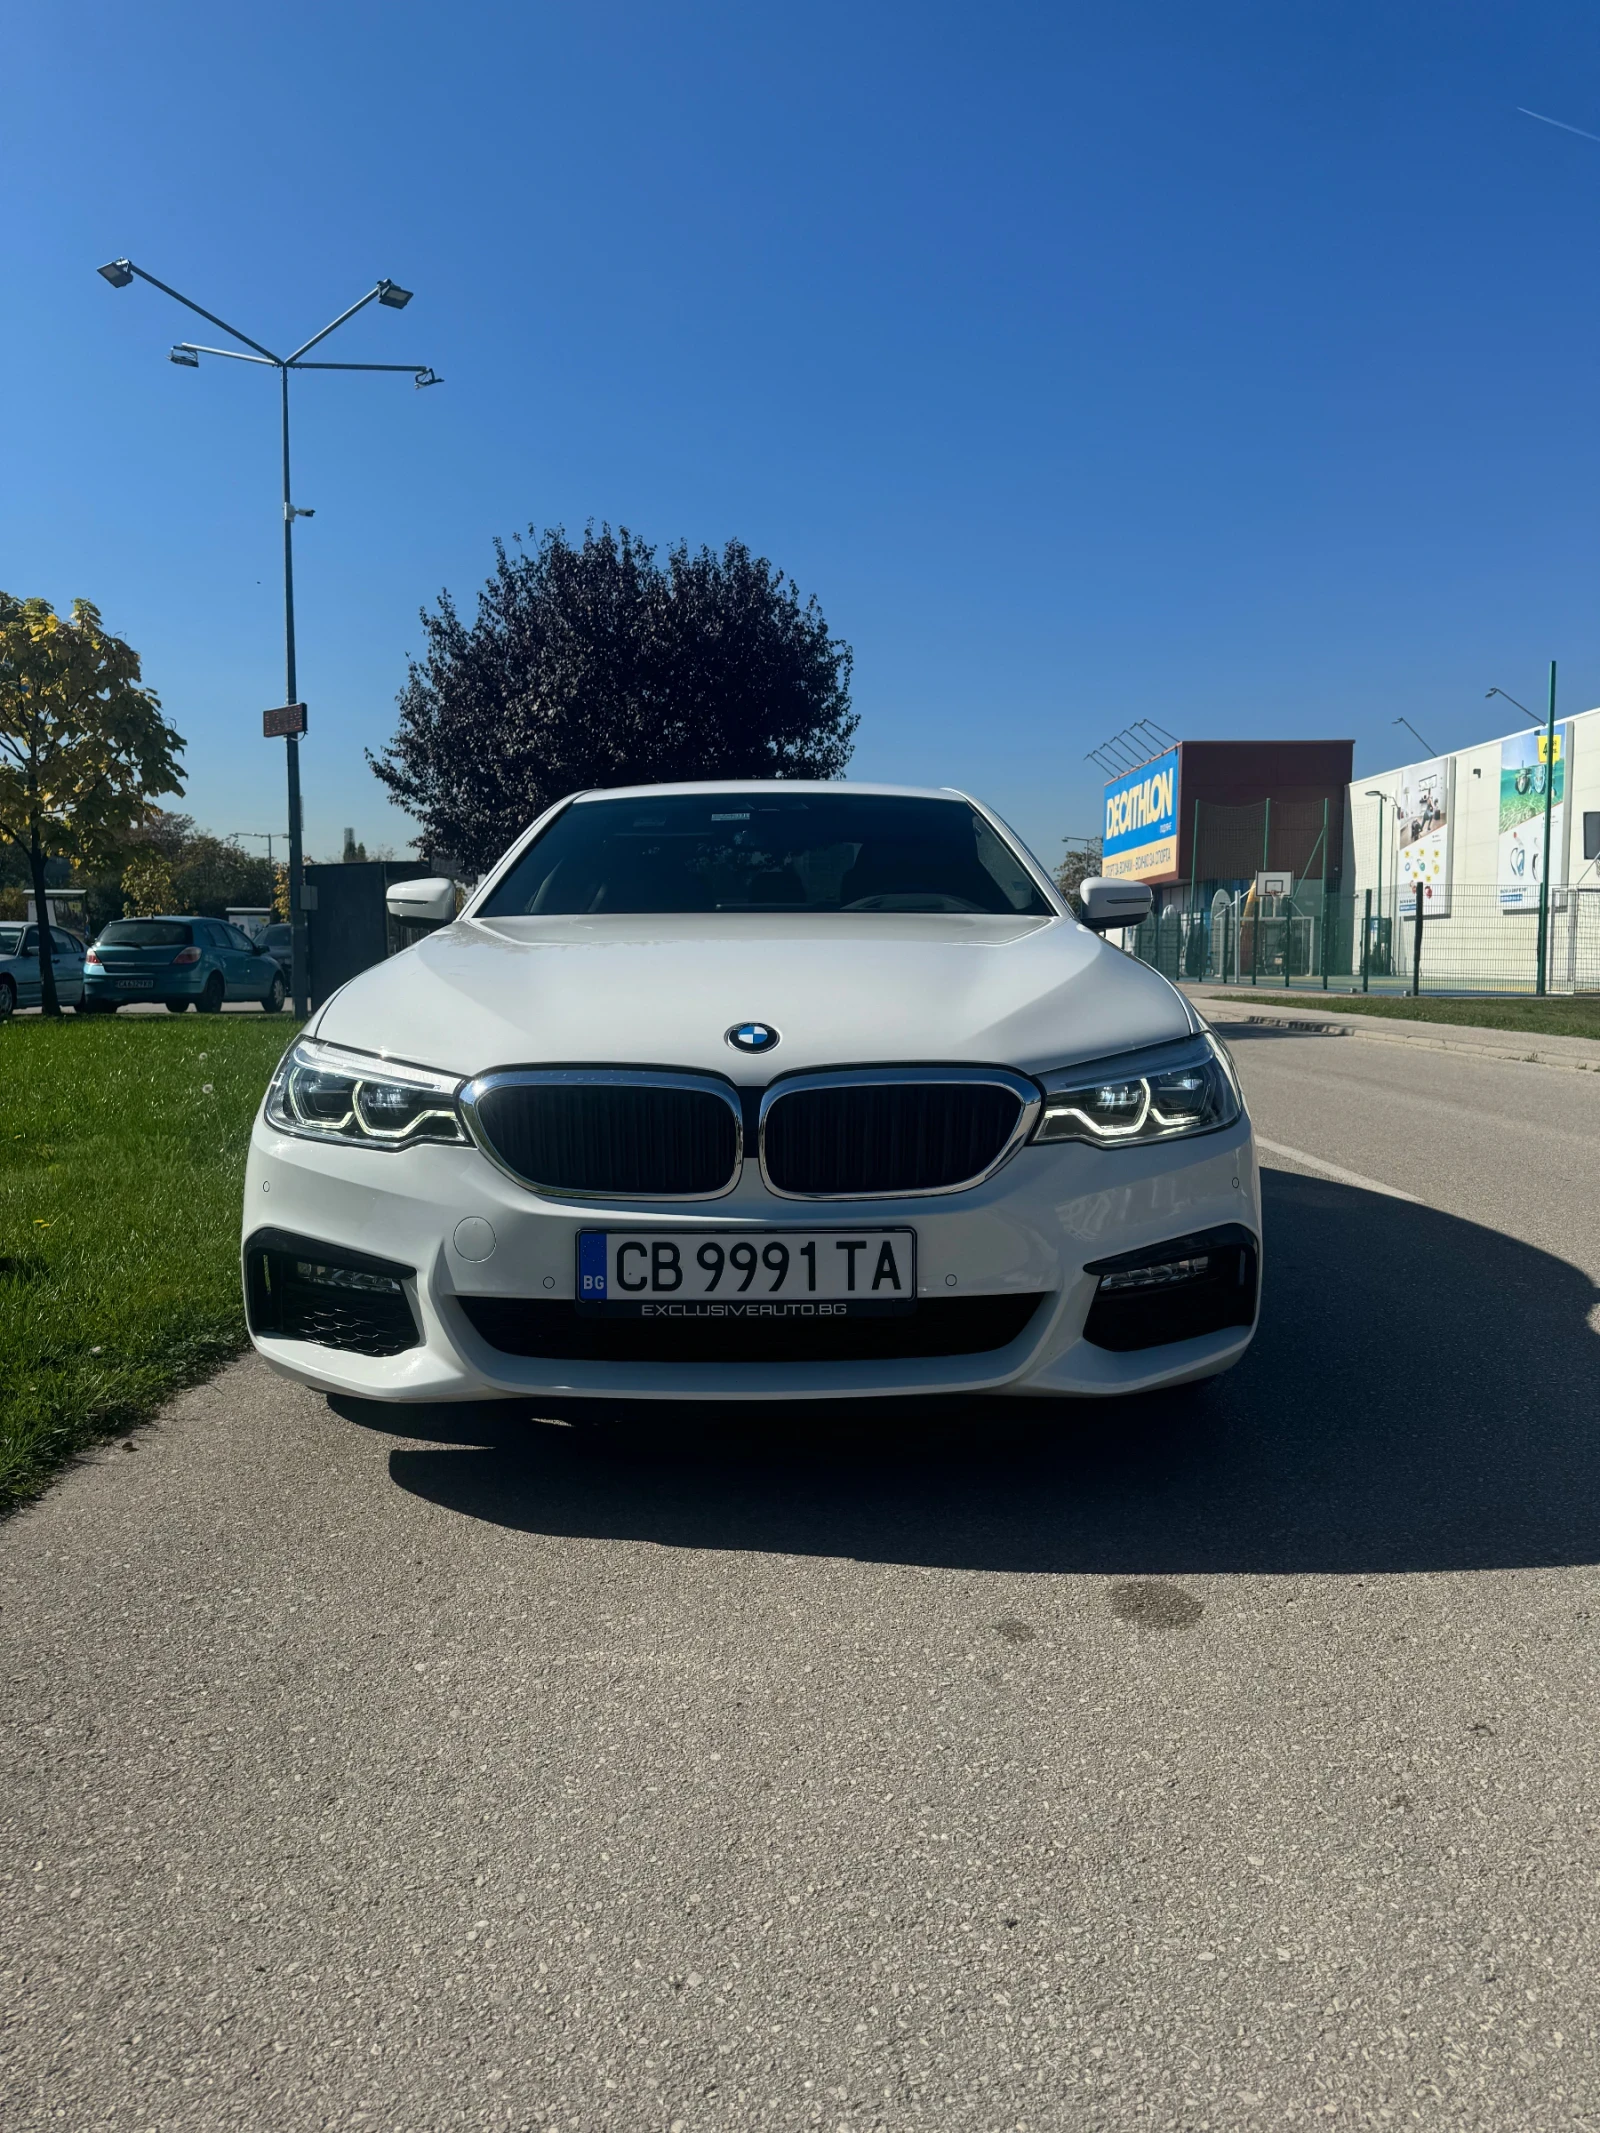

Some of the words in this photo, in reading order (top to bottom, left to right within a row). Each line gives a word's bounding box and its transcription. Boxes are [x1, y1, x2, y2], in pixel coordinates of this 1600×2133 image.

[1106, 768, 1173, 840] DECATHLON
[583, 1275, 605, 1290] BG
[616, 1241, 683, 1292] CB
[696, 1241, 816, 1292] 9991
[836, 1240, 902, 1291] TA
[641, 1303, 848, 1317] EXCLUSIVEAUTO.BG
